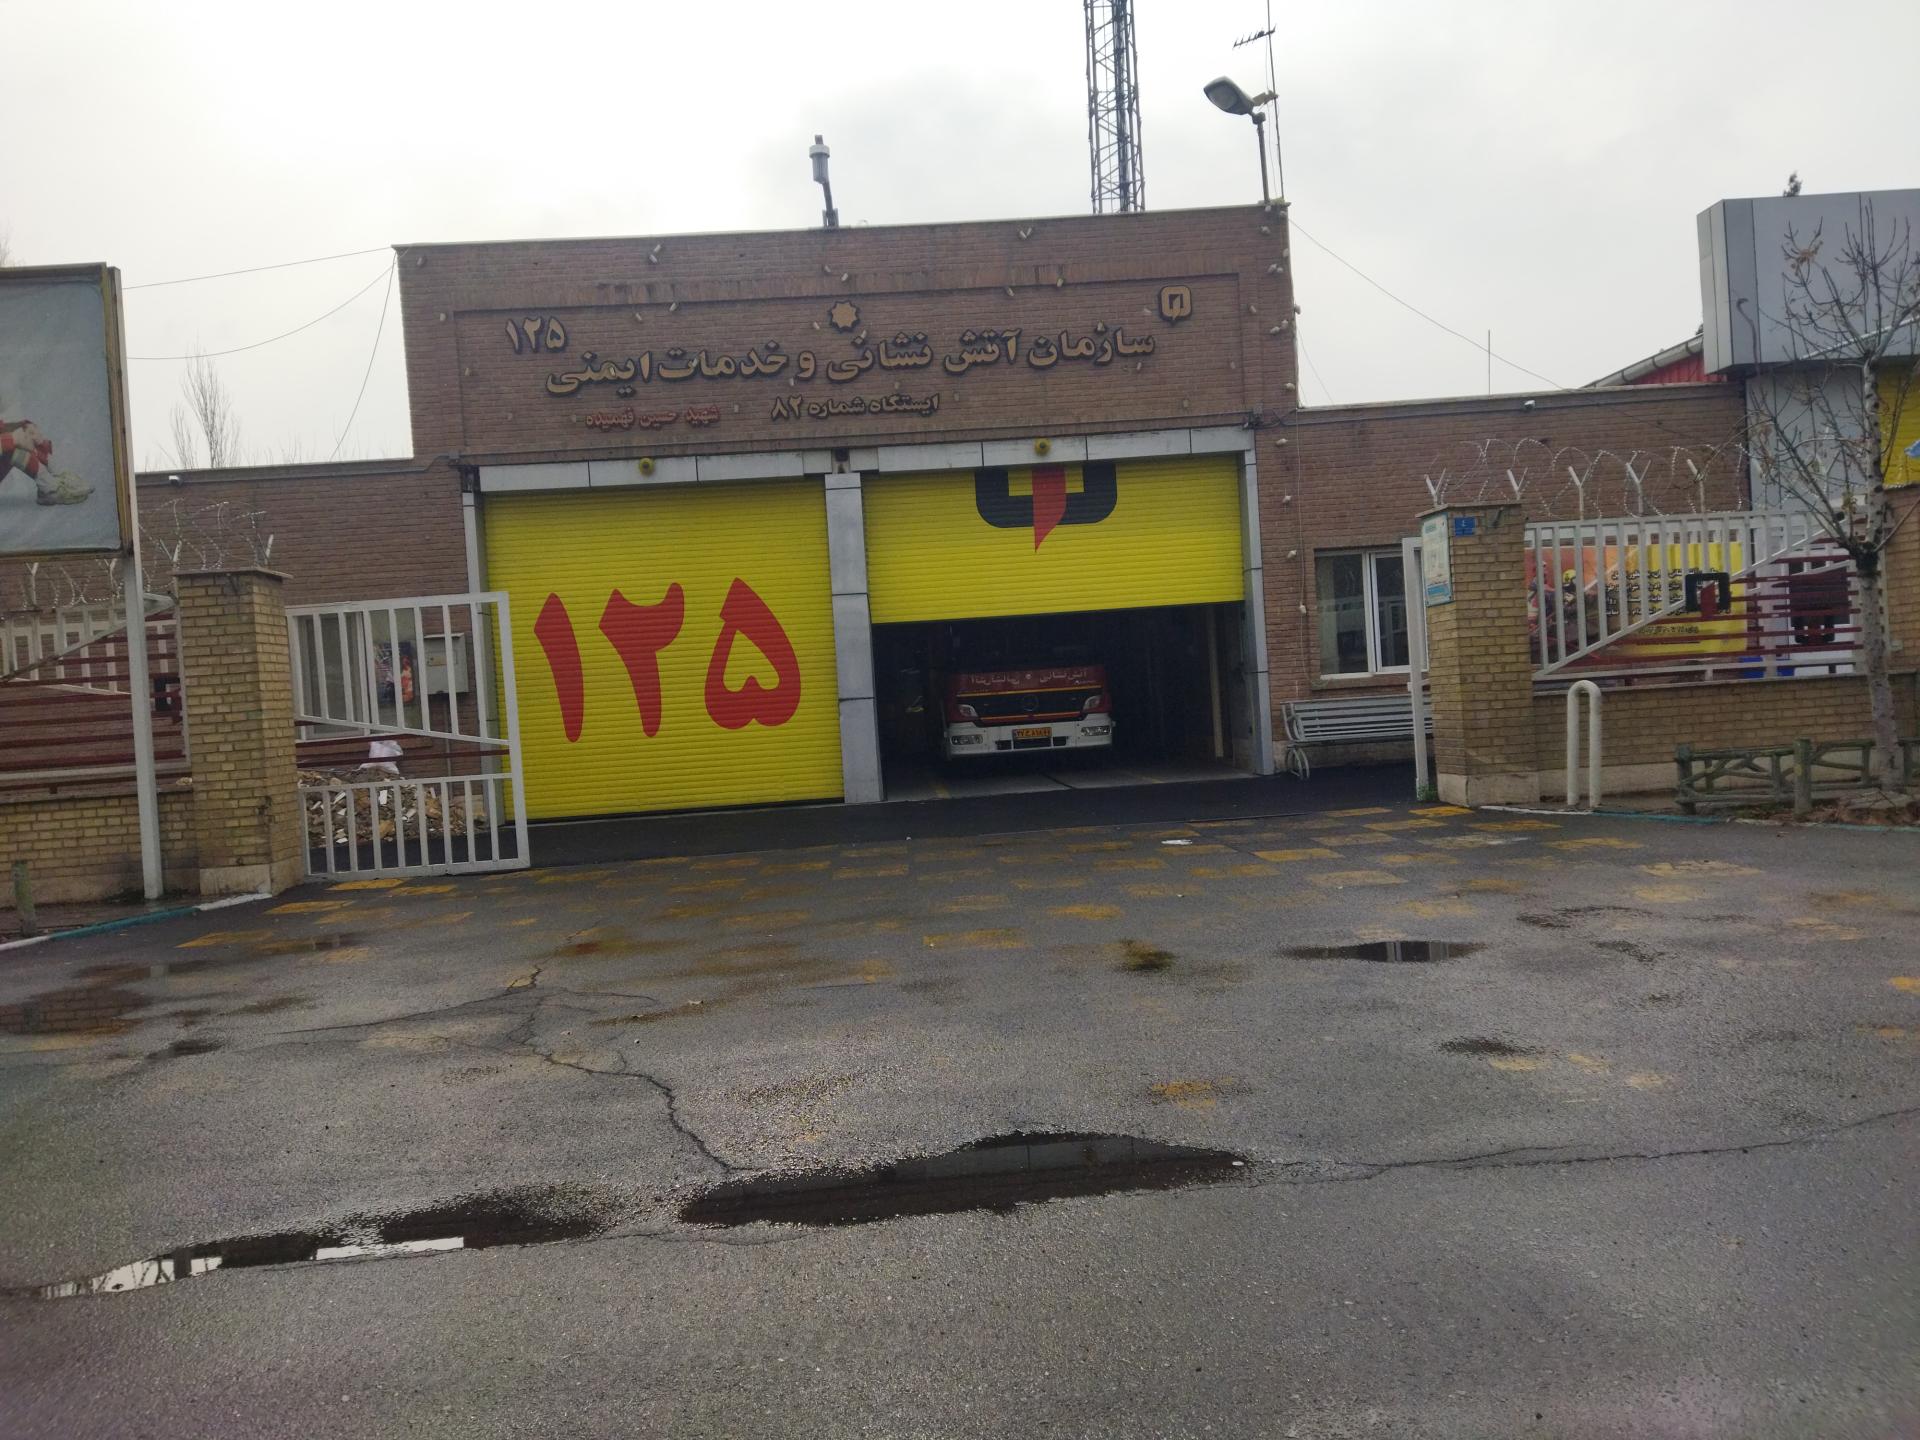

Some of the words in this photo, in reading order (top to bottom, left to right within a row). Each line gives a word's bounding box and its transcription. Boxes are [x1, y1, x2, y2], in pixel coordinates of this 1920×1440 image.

[505, 316, 566, 351] ۱۲۵
[943, 328, 1021, 373] آتش
[1027, 321, 1156, 368] سازمان
[545, 350, 651, 395] ایمنی
[656, 339, 789, 380] خدمات
[798, 350, 816, 379] و
[826, 331, 934, 382] نشانی
[639, 411, 679, 430] حسین
[686, 405, 721, 427] شهید
[771, 393, 803, 421] ۸۲
[807, 396, 867, 419] شماره
[869, 393, 941, 416] ایستگاه
[533, 576, 801, 742] ۱۲۵
